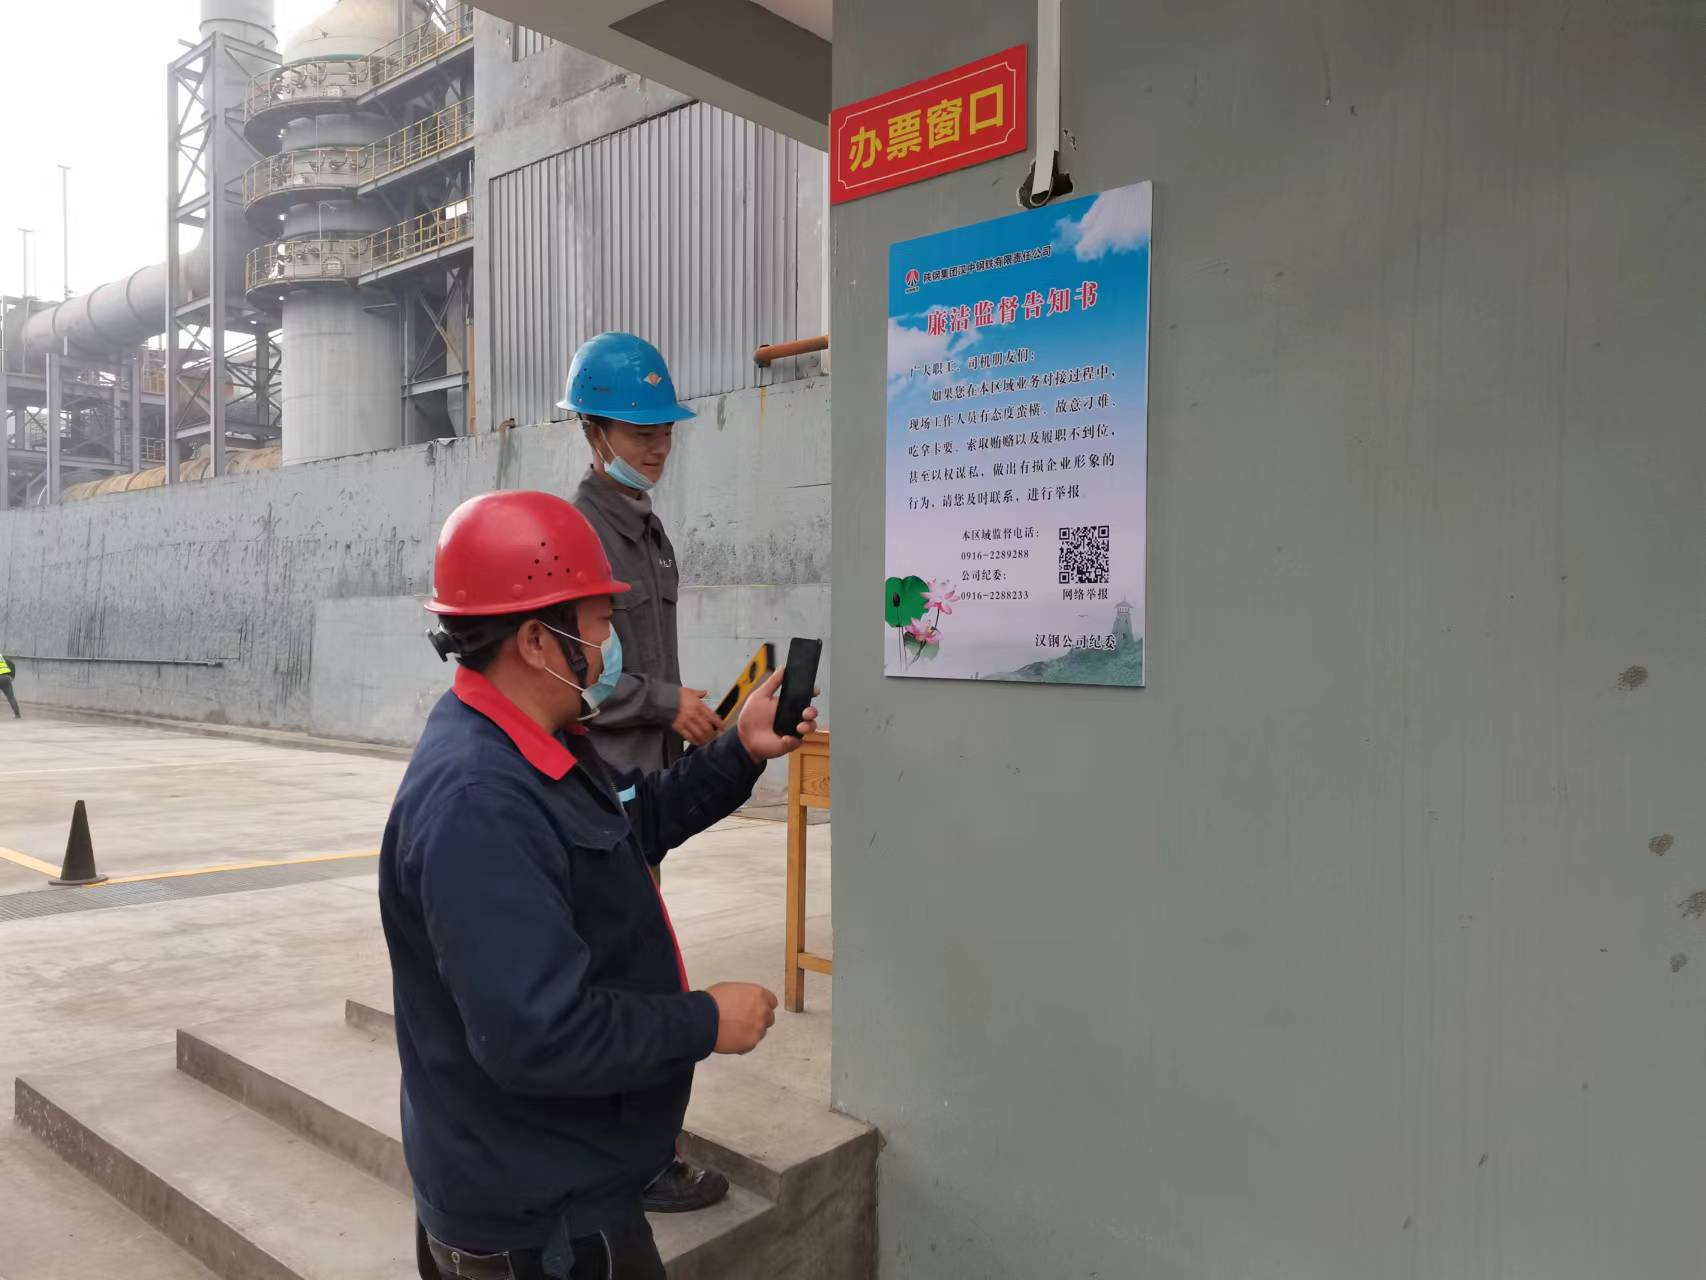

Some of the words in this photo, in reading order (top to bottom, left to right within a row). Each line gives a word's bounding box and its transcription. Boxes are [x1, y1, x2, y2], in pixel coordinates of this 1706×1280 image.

[849, 84, 1004, 172] 办票窗口
[927, 281, 1098, 336] 廉洁监督告知书
[961, 549, 1030, 560] 0916-2289288
[961, 590, 1030, 601] 0916-2288233
[1062, 588, 1109, 601] 网络举报
[1034, 634, 1116, 650] 汉钢公司纪委
